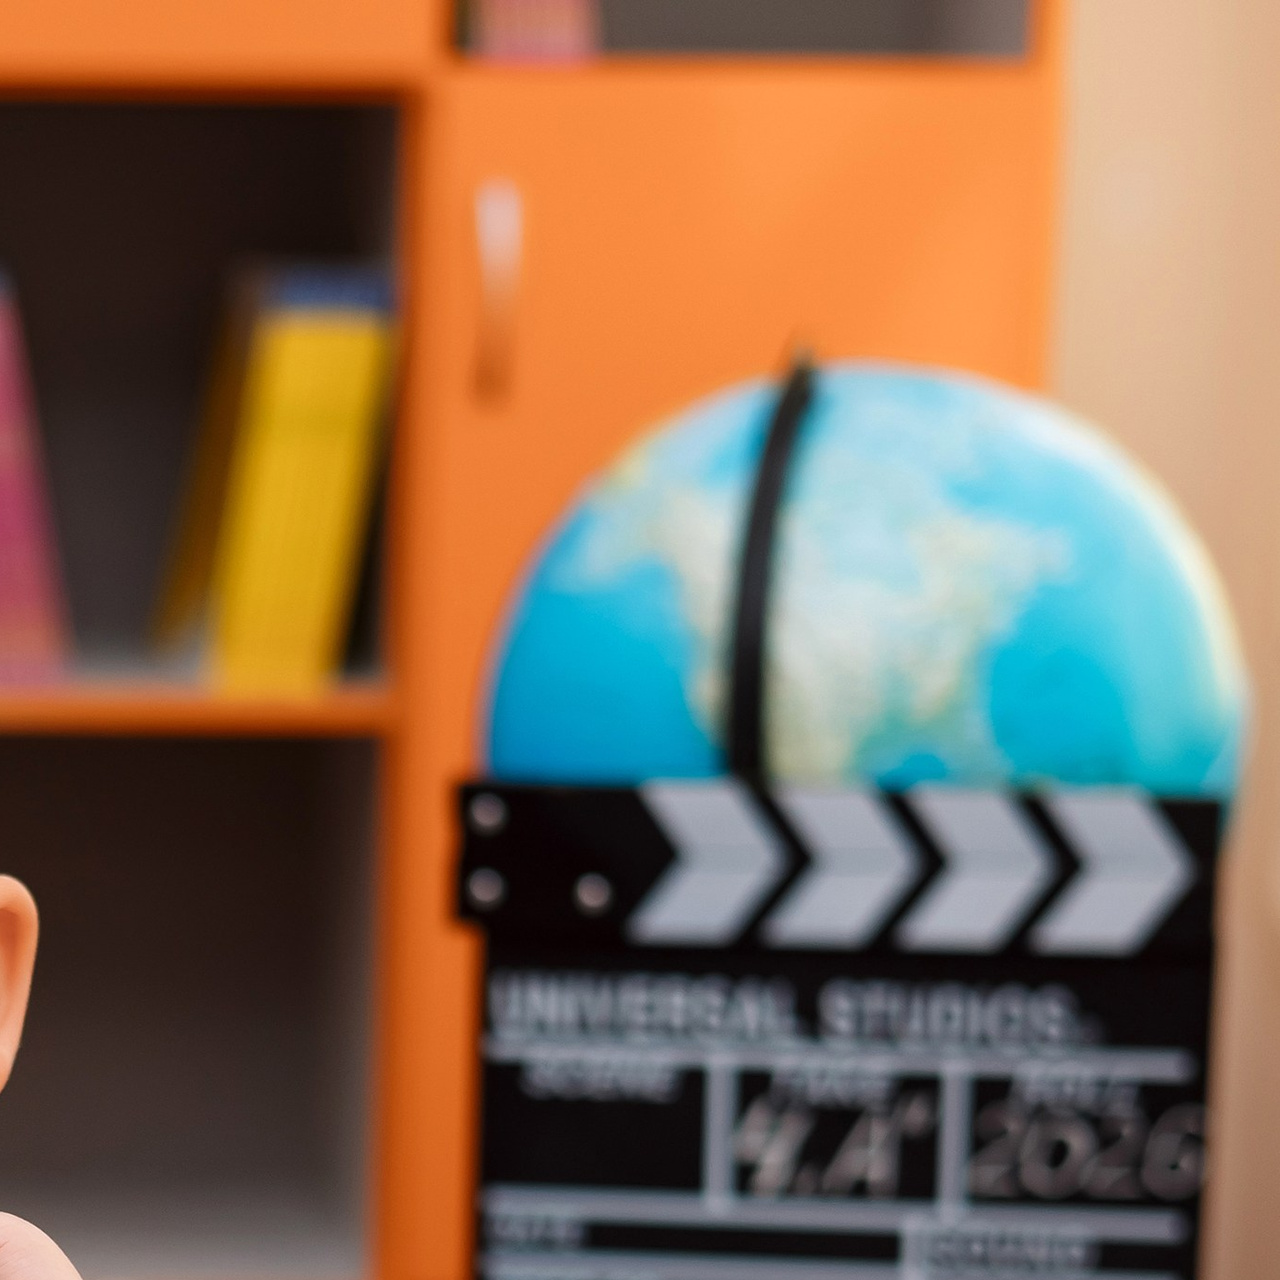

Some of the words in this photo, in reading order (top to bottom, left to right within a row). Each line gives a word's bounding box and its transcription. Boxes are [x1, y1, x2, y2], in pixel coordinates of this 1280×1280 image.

[490, 971, 798, 1039] UNIVERSAL
[819, 982, 1078, 1048] STUDIOS
[966, 1102, 1207, 1200] 2026
